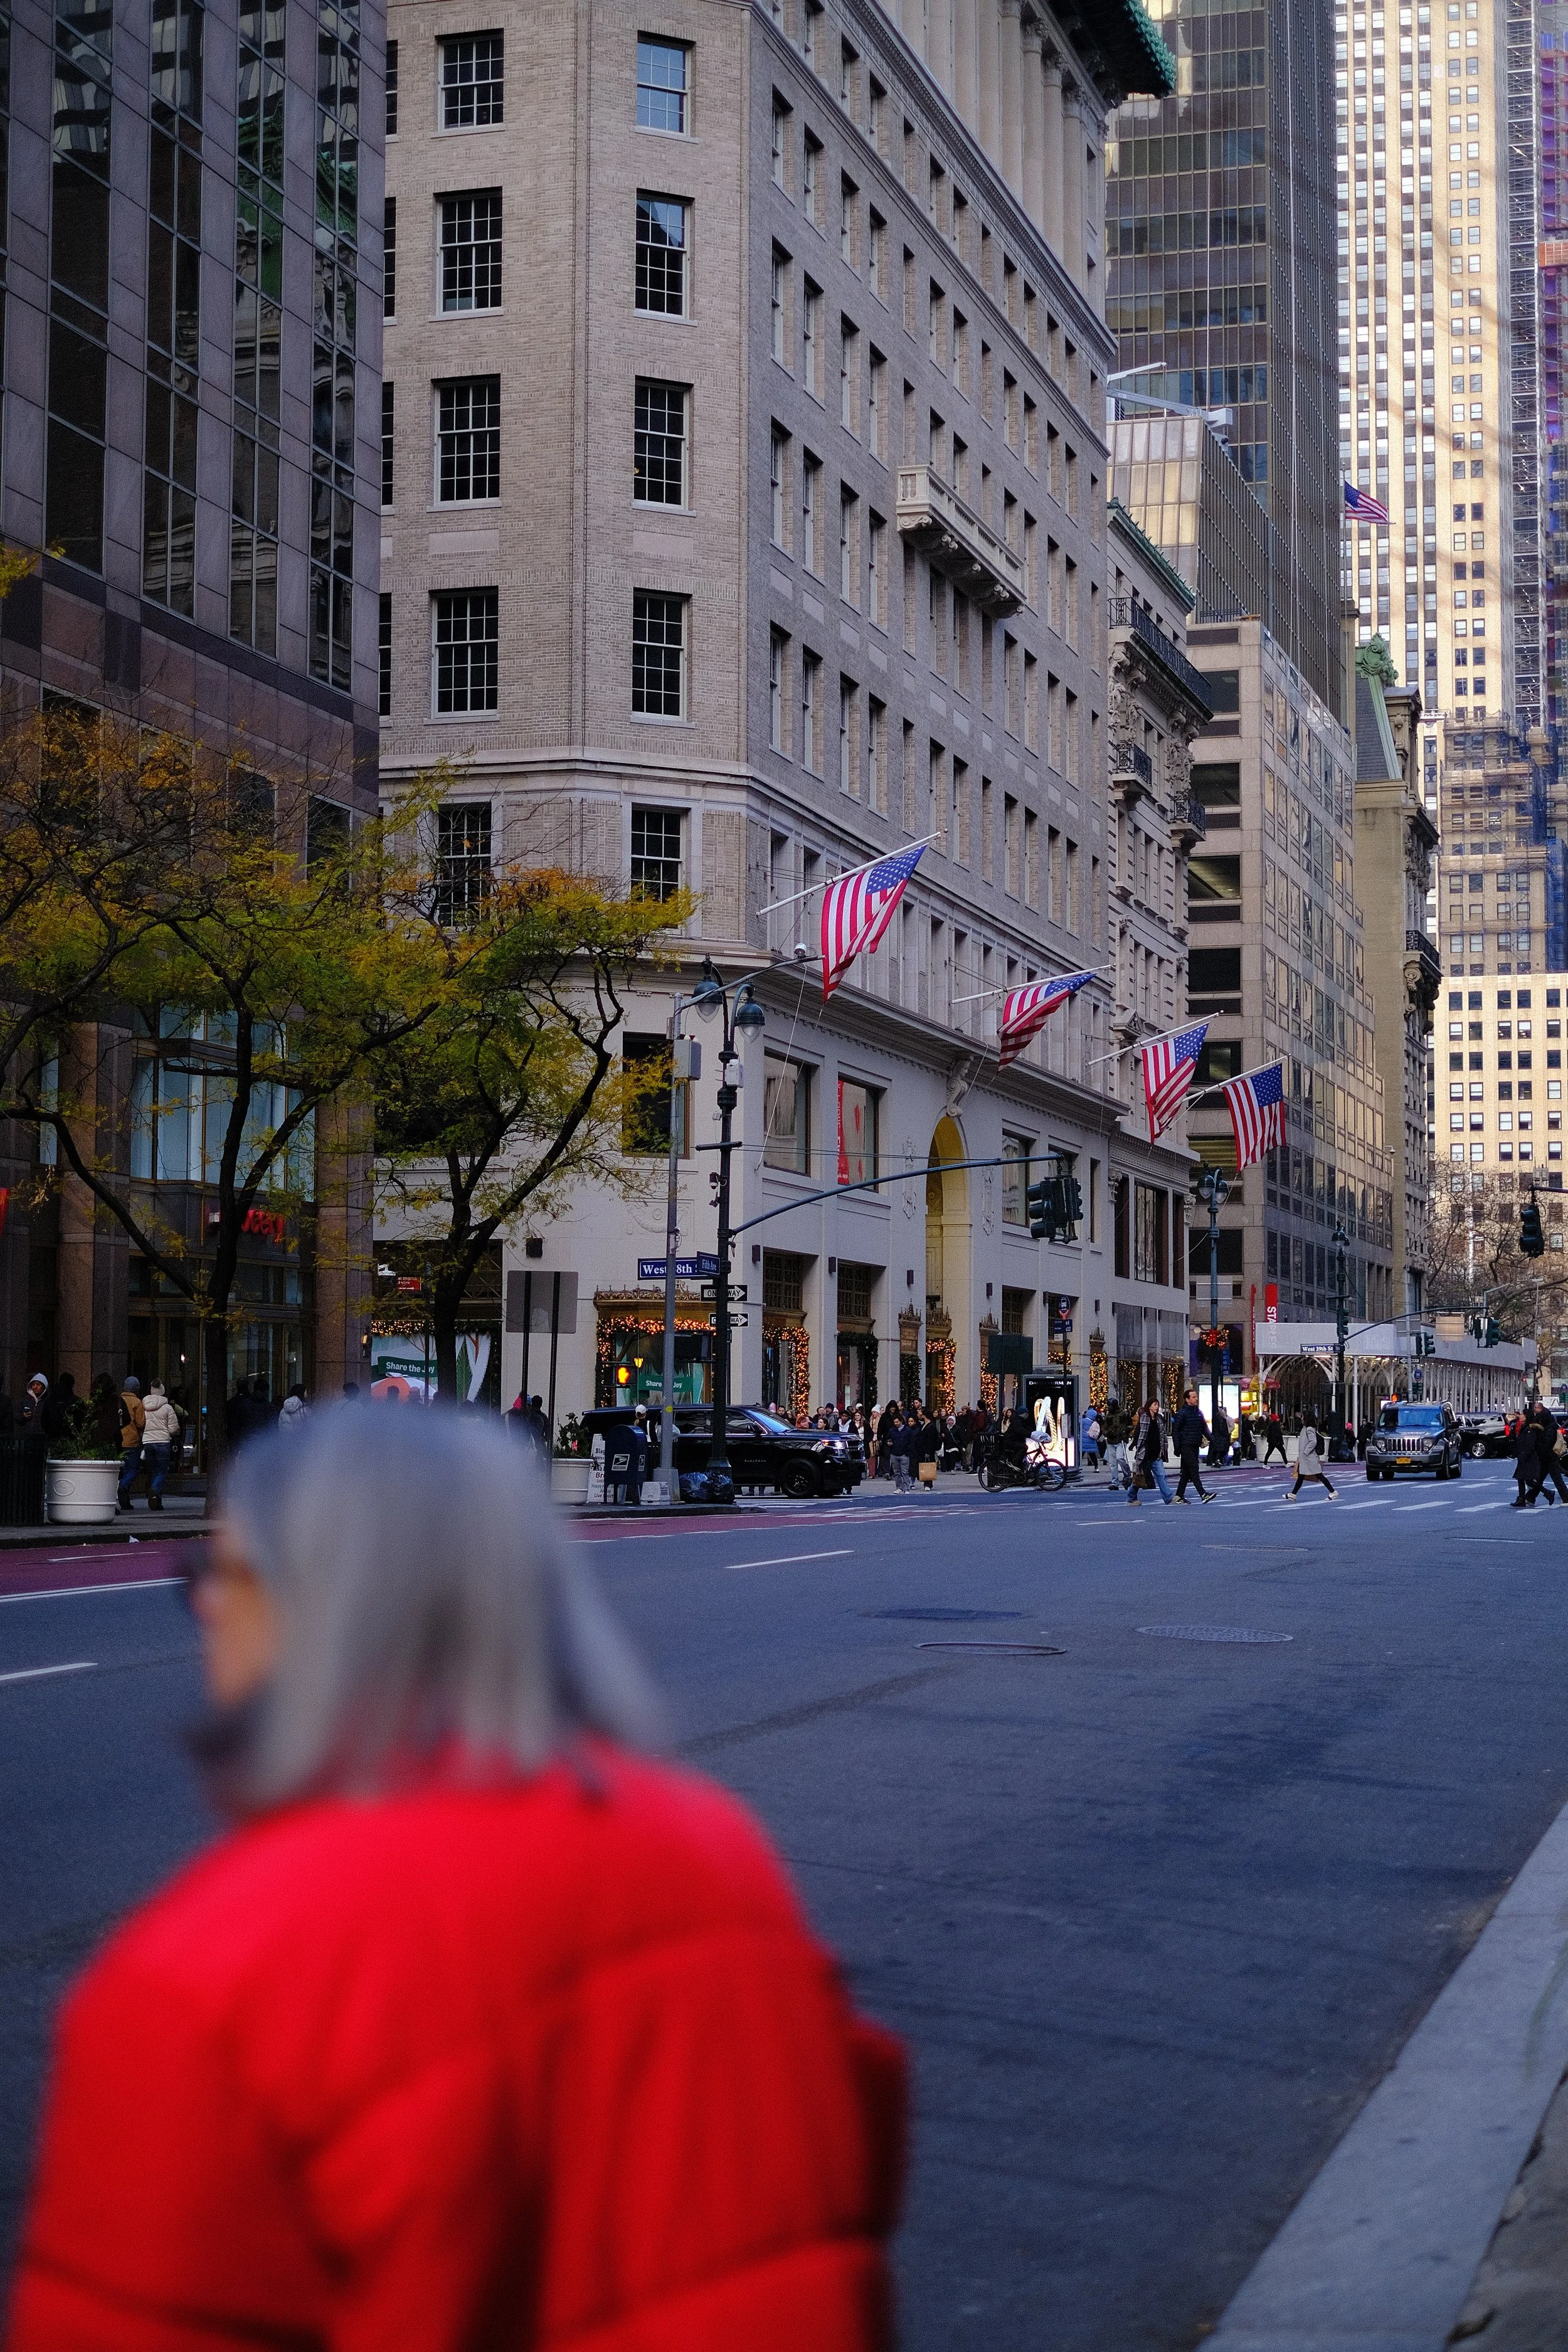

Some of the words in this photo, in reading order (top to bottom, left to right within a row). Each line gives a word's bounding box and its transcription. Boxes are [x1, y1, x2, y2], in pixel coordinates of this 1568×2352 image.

[675, 1263, 692, 1273] 8th
[702, 1259, 710, 1269] Fifth
[386, 1362, 408, 1371] Share
[408, 1364, 421, 1373] the
[421, 1365, 435, 1374] Jy
